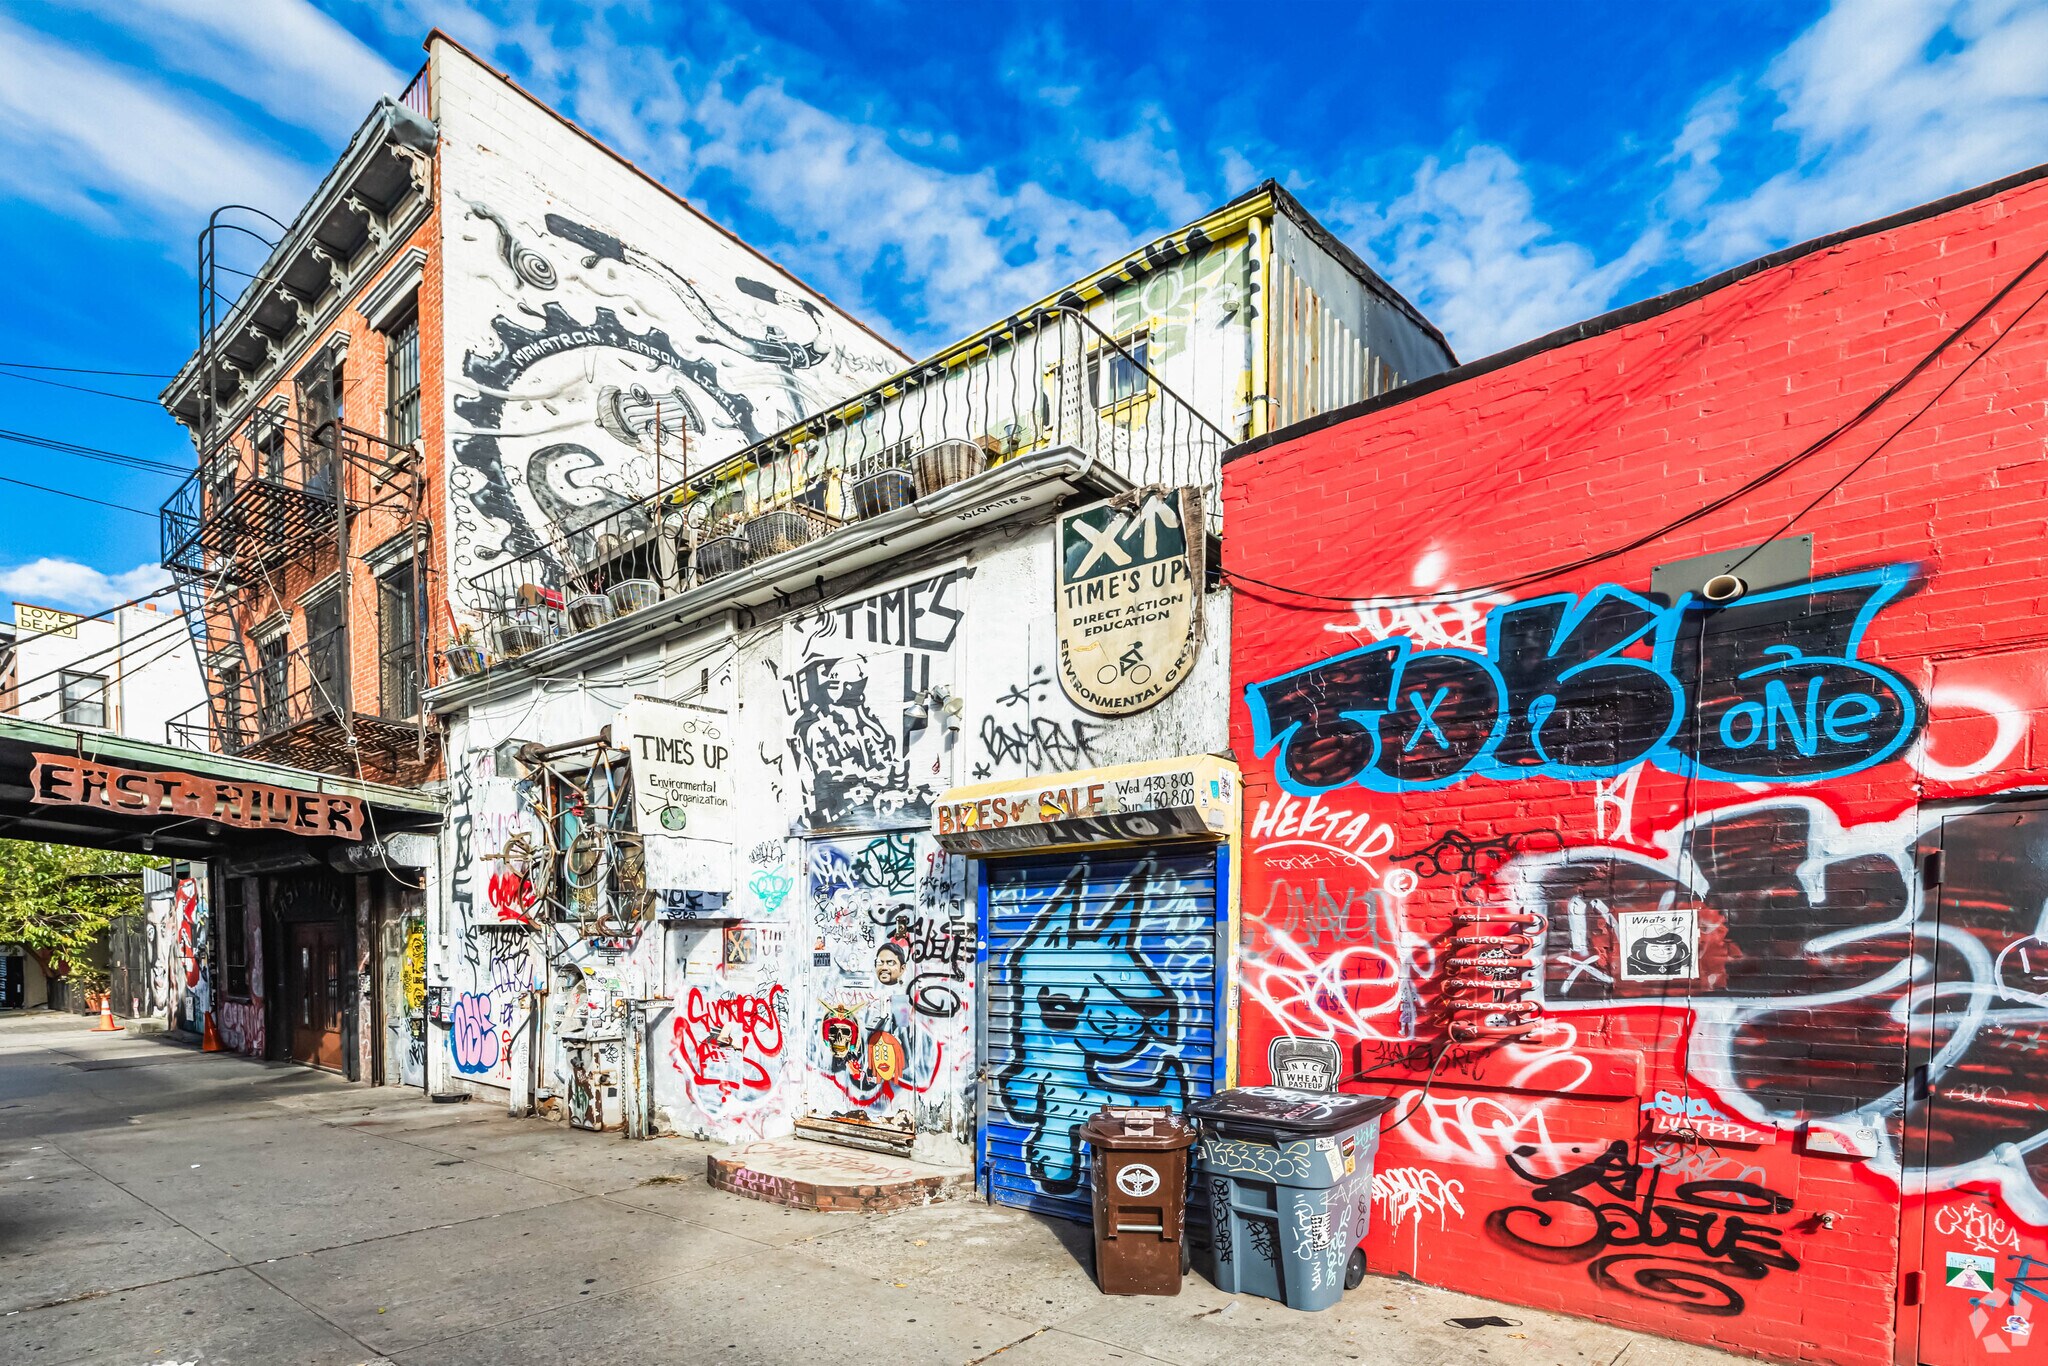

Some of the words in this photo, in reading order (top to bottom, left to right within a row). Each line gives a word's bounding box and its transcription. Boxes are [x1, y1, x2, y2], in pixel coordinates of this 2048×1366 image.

[512, 330, 600, 367] MAKATRON
[628, 338, 681, 369] BARON
[1064, 570, 1141, 609] TIME'S
[21, 606, 69, 624] LOVE
[1073, 608, 1121, 627] DIRECT
[1126, 594, 1184, 615] ACTION
[1084, 610, 1170, 637] EDUCATION
[1061, 639, 1163, 708] ENVIRONMENTAL
[633, 734, 695, 766] TIME'S
[703, 744, 728, 770] UP
[649, 774, 717, 793] Environmental
[41, 764, 182, 809] EAST
[211, 784, 353, 832] RIVER
[671, 788, 728, 808] Organization
[1459, 914, 1490, 922] ASH
[1632, 915, 1666, 925] Whats
[1671, 916, 1684, 926] up
[1291, 1062, 1319, 1072] NYC
[1286, 1073, 1324, 1083] WHEAT
[1288, 1081, 1323, 1090] PASTEUP
